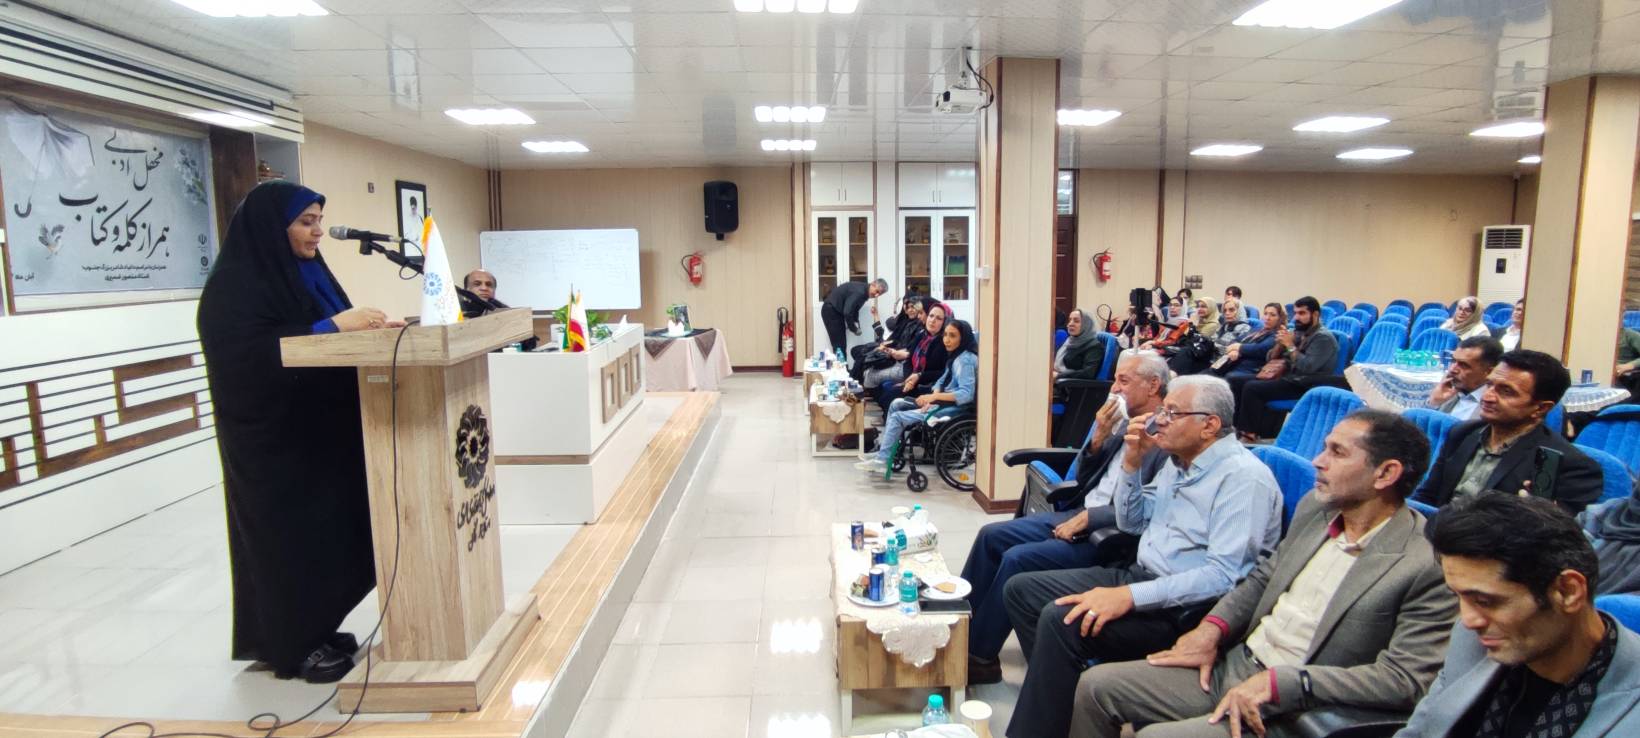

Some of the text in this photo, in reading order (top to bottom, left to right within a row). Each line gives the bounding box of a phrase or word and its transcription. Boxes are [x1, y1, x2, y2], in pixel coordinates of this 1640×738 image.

[104, 130, 164, 191] محفل ادبی
[58, 192, 129, 247] کتاب
[111, 224, 120, 244] و
[112, 197, 153, 254] کلمه
